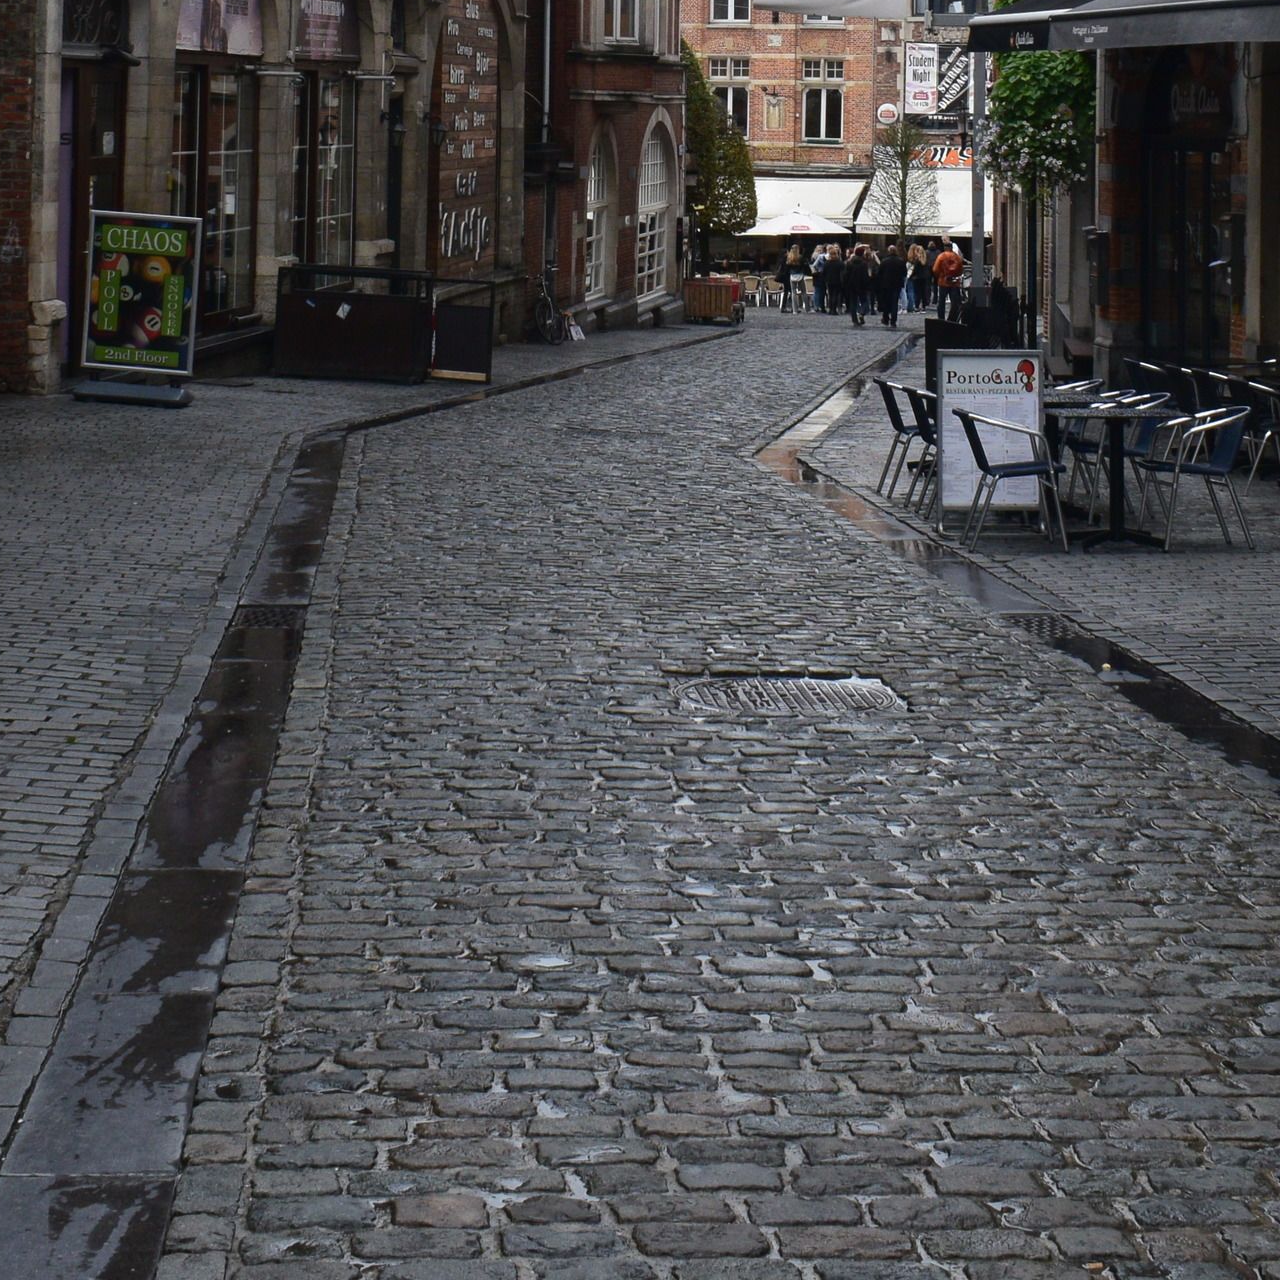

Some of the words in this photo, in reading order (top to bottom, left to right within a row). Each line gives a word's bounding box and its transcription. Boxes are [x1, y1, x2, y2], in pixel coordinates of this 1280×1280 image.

[465, 0, 479, 20] alus
[908, 54, 935, 67] Student
[912, 69, 931, 83] Night
[937, 55, 968, 94] STERKEN
[938, 73, 968, 109] DINSDAG
[107, 227, 183, 253] CHAOS
[103, 271, 116, 330] POOL
[167, 277, 179, 336] SNOOKER
[104, 348, 131, 360] 2nd
[135, 350, 169, 364] Floor
